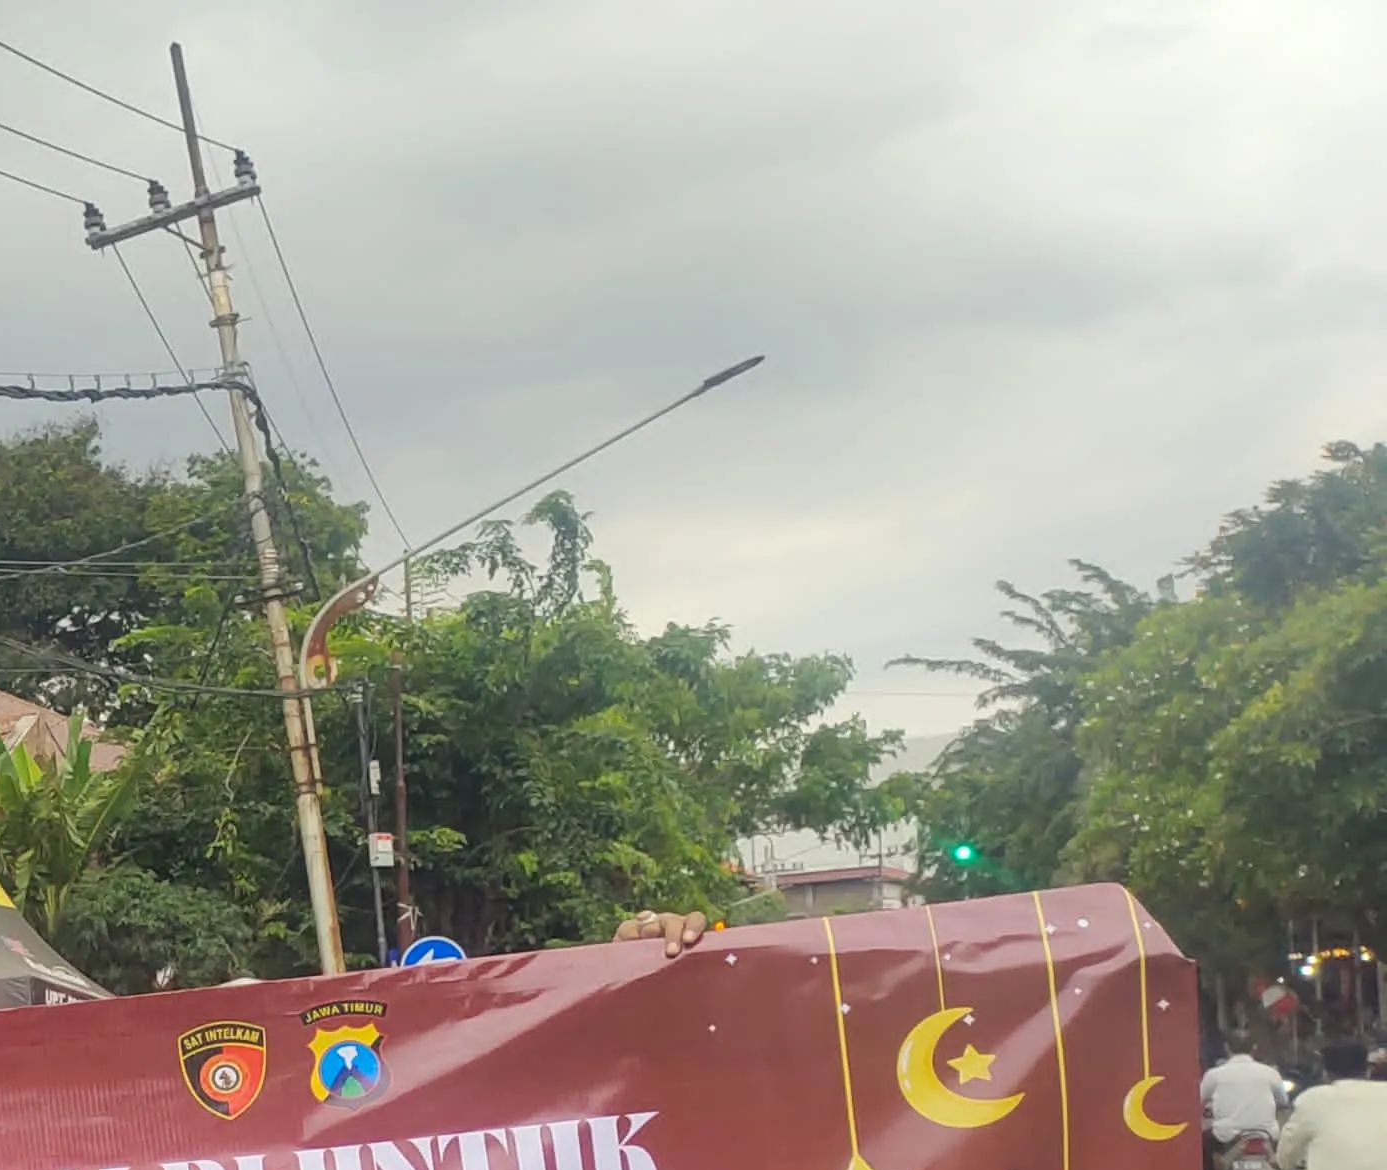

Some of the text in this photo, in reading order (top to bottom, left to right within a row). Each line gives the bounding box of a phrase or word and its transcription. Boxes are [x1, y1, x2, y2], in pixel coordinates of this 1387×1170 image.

[306, 1002, 384, 1023] JAWA TIMUR
[183, 1028, 260, 1050] SAT INTELKAM
